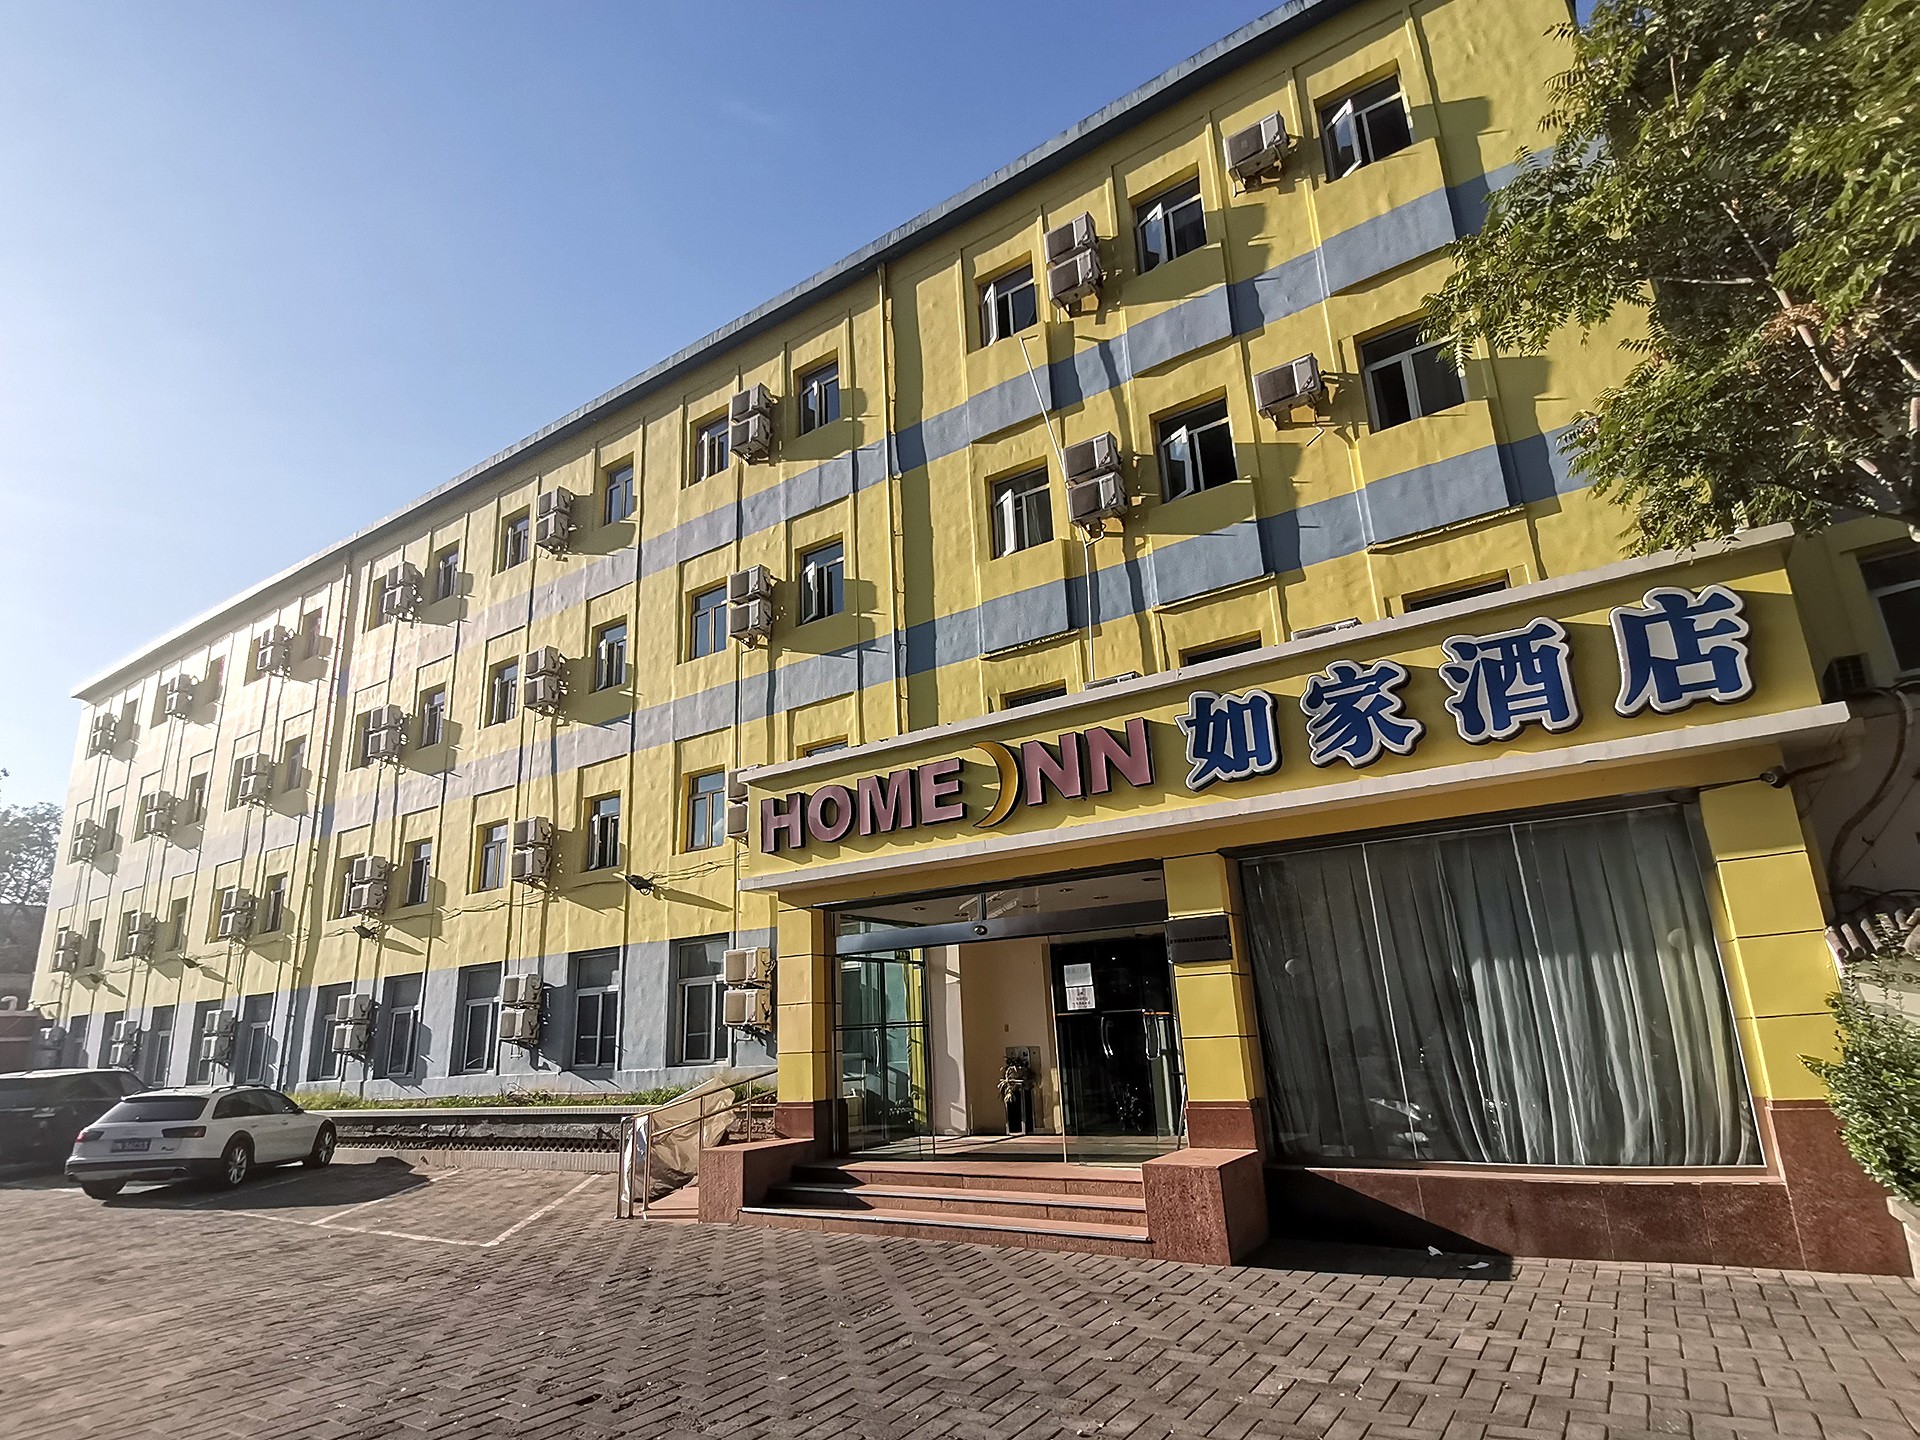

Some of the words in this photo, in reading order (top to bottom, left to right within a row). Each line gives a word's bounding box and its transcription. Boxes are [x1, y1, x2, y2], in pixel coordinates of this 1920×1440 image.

[1175, 584, 1753, 792] 如家酒店
[761, 757, 965, 854] HOME
